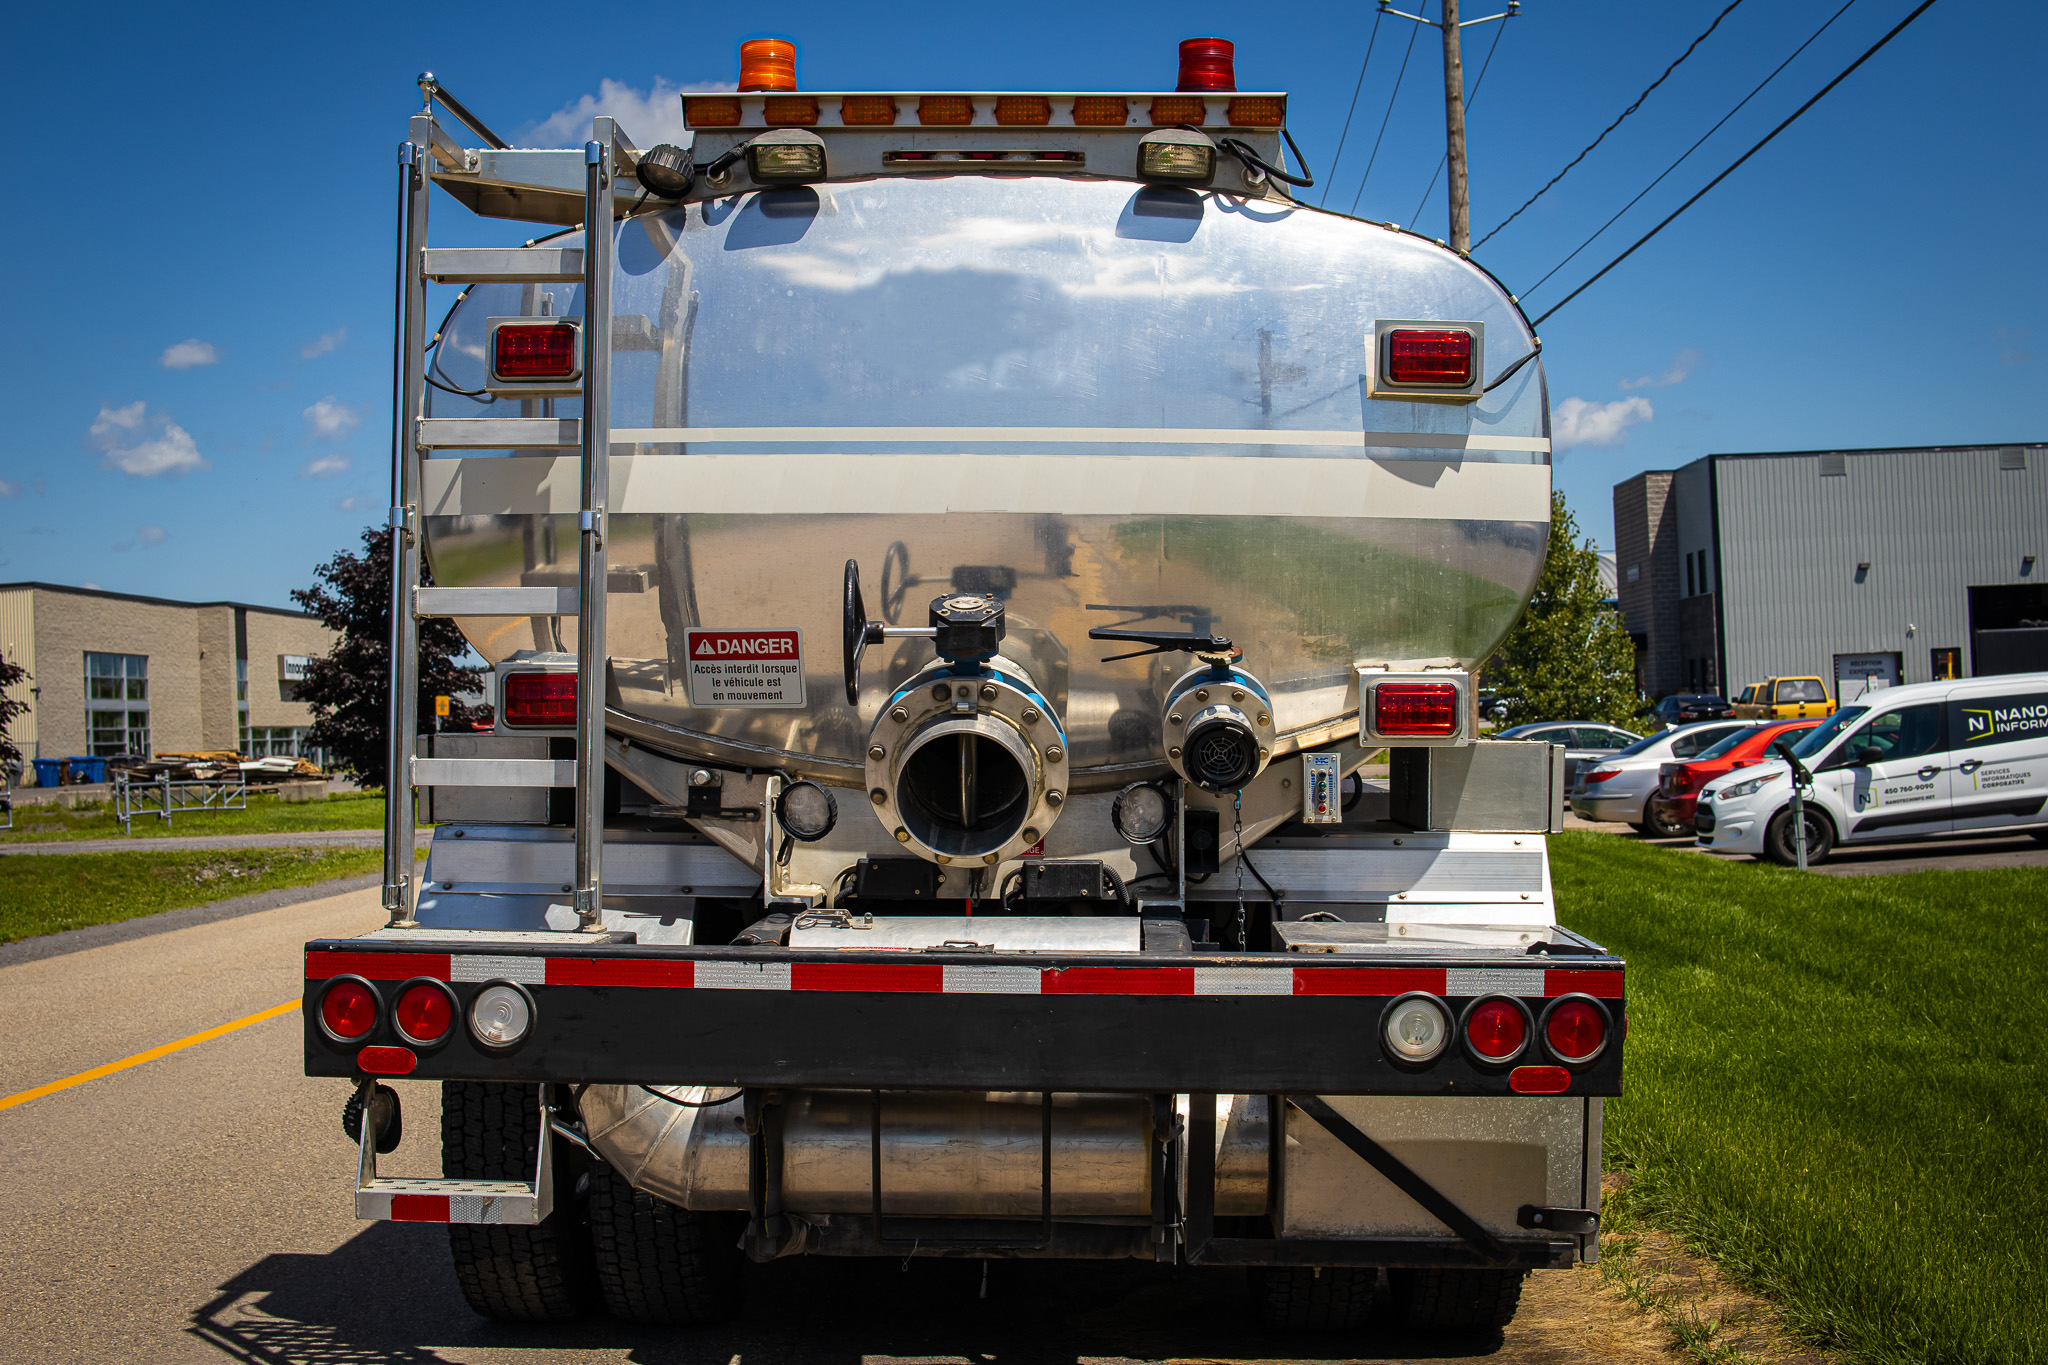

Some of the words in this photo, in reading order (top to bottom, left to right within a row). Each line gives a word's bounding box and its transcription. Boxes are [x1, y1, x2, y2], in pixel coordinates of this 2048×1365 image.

[717, 638, 793, 654] DANGER
[694, 664, 722, 674] Accès
[724, 663, 759, 673] interdit
[761, 663, 798, 675] lorsque
[712, 677, 721, 687] le
[724, 677, 764, 687] véhicule
[766, 677, 782, 687] est
[712, 692, 724, 700] en
[727, 690, 783, 700] mouvement
[1981, 768, 2010, 776] SERVICES
[1981, 772, 2031, 782] INFORMATIQUES
[1900, 783, 1934, 793] 760-9090
[1982, 779, 2025, 789] CORPORATIFS
